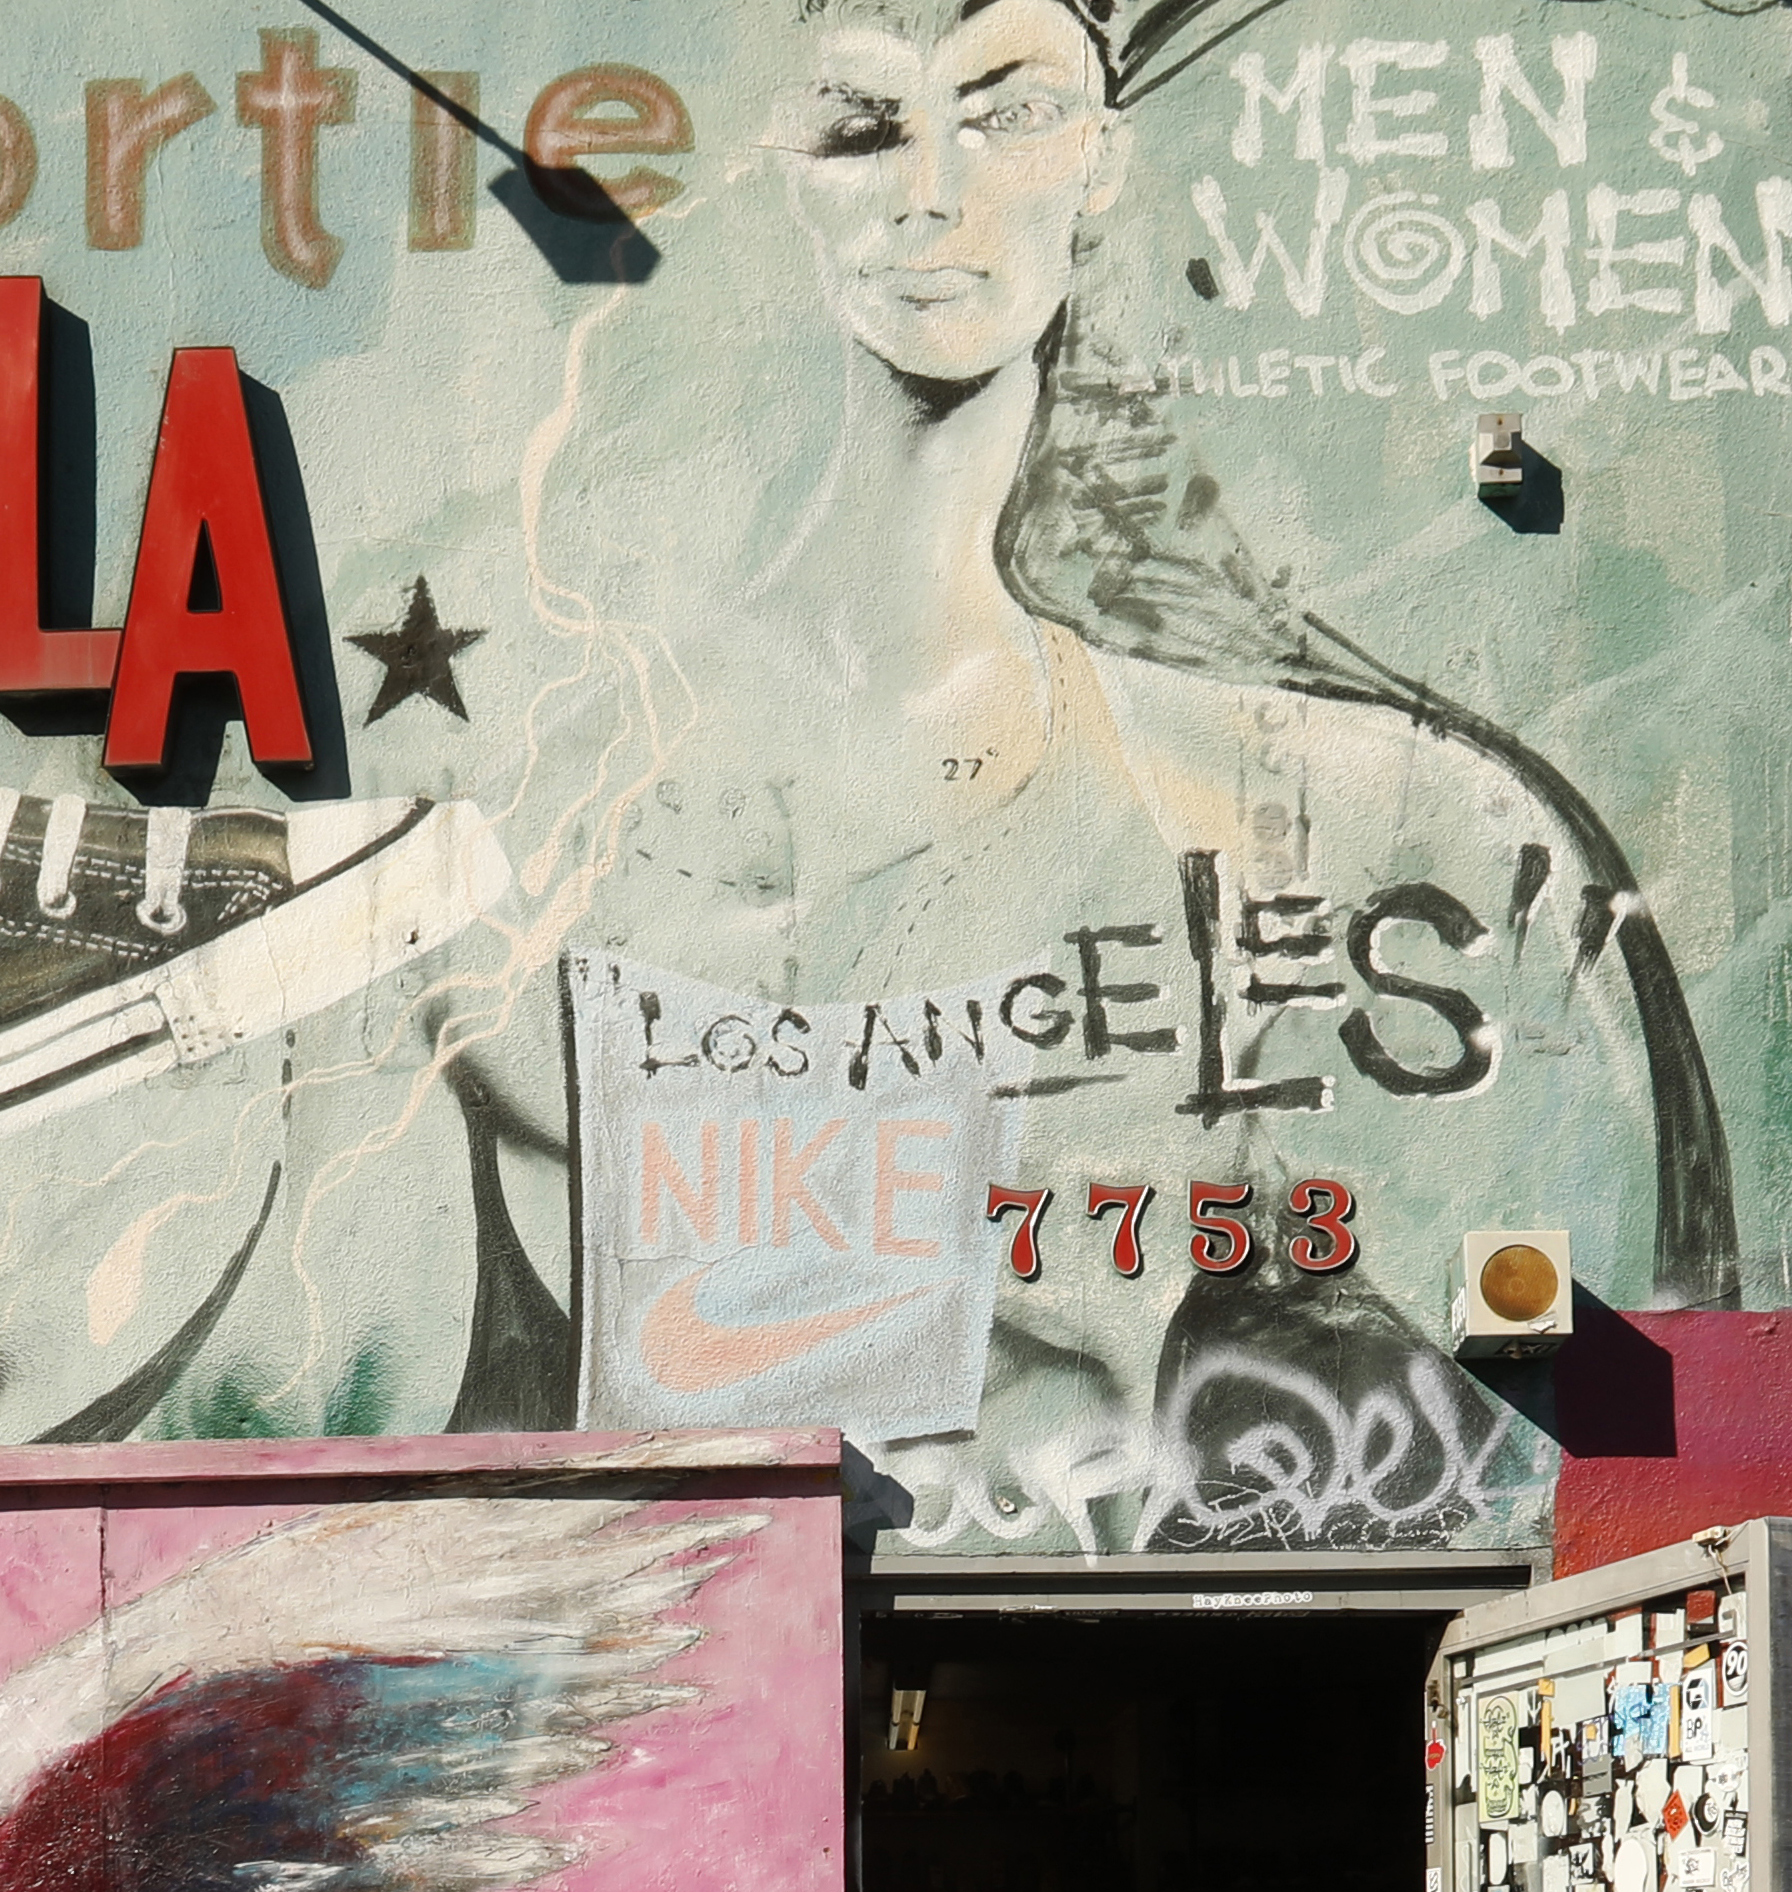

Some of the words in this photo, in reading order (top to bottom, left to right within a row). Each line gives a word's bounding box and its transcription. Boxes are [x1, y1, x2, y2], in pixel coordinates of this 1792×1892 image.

[1230, 30, 1598, 172] MEN
[1648, 50, 1726, 178] &
[1428, 346, 1792, 402] FOOTWEAR
[636, 1114, 956, 1260] NIKE
[984, 1176, 1363, 1282] 7753
